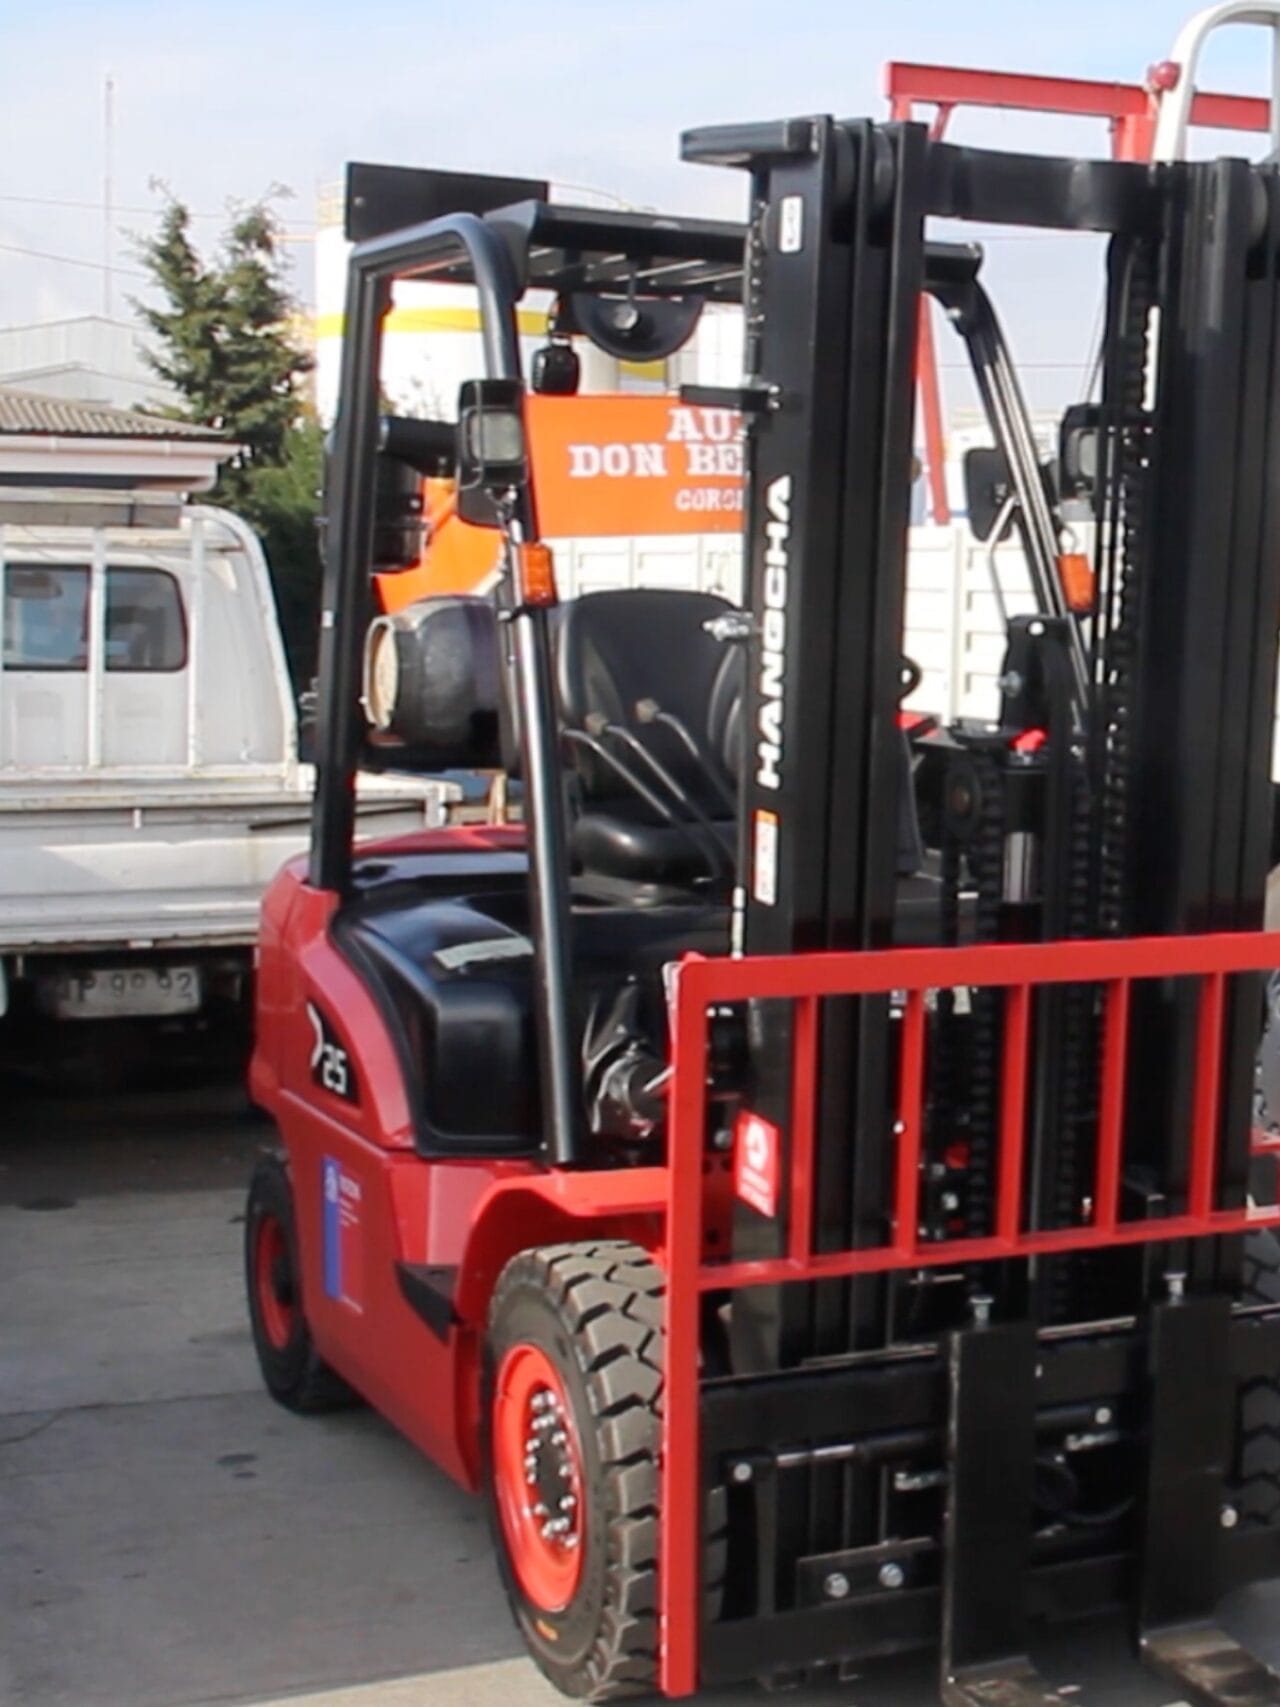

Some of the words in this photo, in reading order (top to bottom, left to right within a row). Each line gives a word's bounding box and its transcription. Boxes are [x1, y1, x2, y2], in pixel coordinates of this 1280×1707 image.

[568, 444, 667, 478] DON
[686, 443, 745, 477] BE
[757, 475, 791, 791] HANGCHA
[322, 1043, 347, 1095] 25
